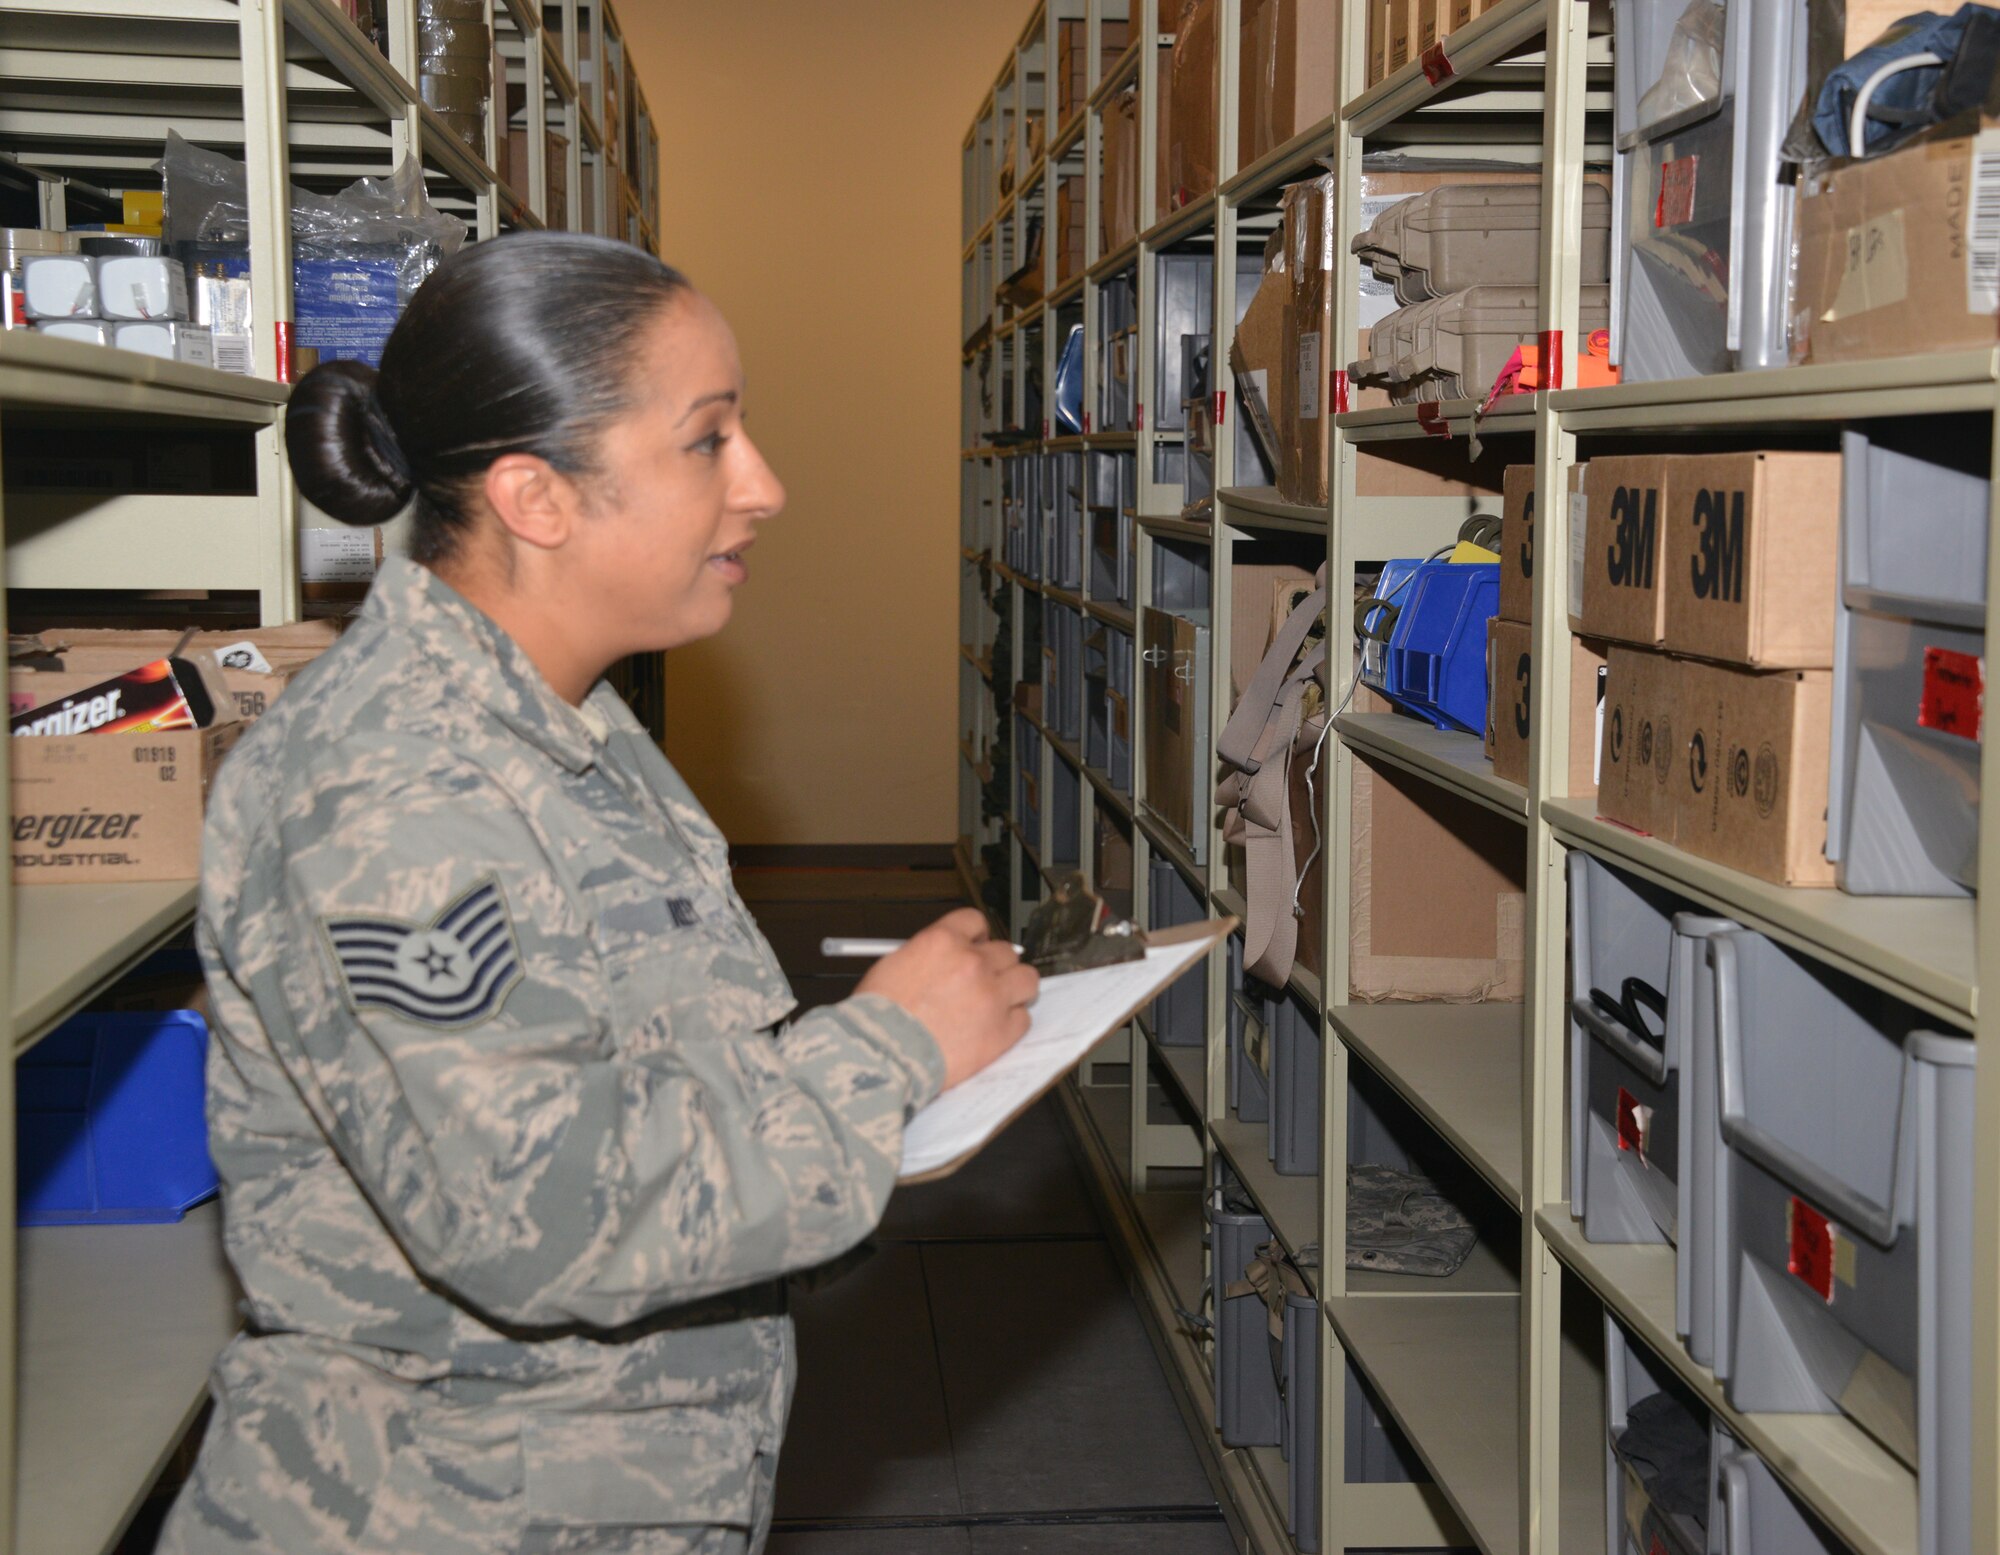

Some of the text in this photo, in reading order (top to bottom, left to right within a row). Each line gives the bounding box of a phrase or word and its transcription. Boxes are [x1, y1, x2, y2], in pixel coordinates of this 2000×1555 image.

[1947, 163, 1964, 259] MADE
[1608, 486, 1657, 589] 3M
[1691, 488, 1745, 603] 3M
[160, 766, 177, 782] 02
[11, 807, 142, 848] ergizer
